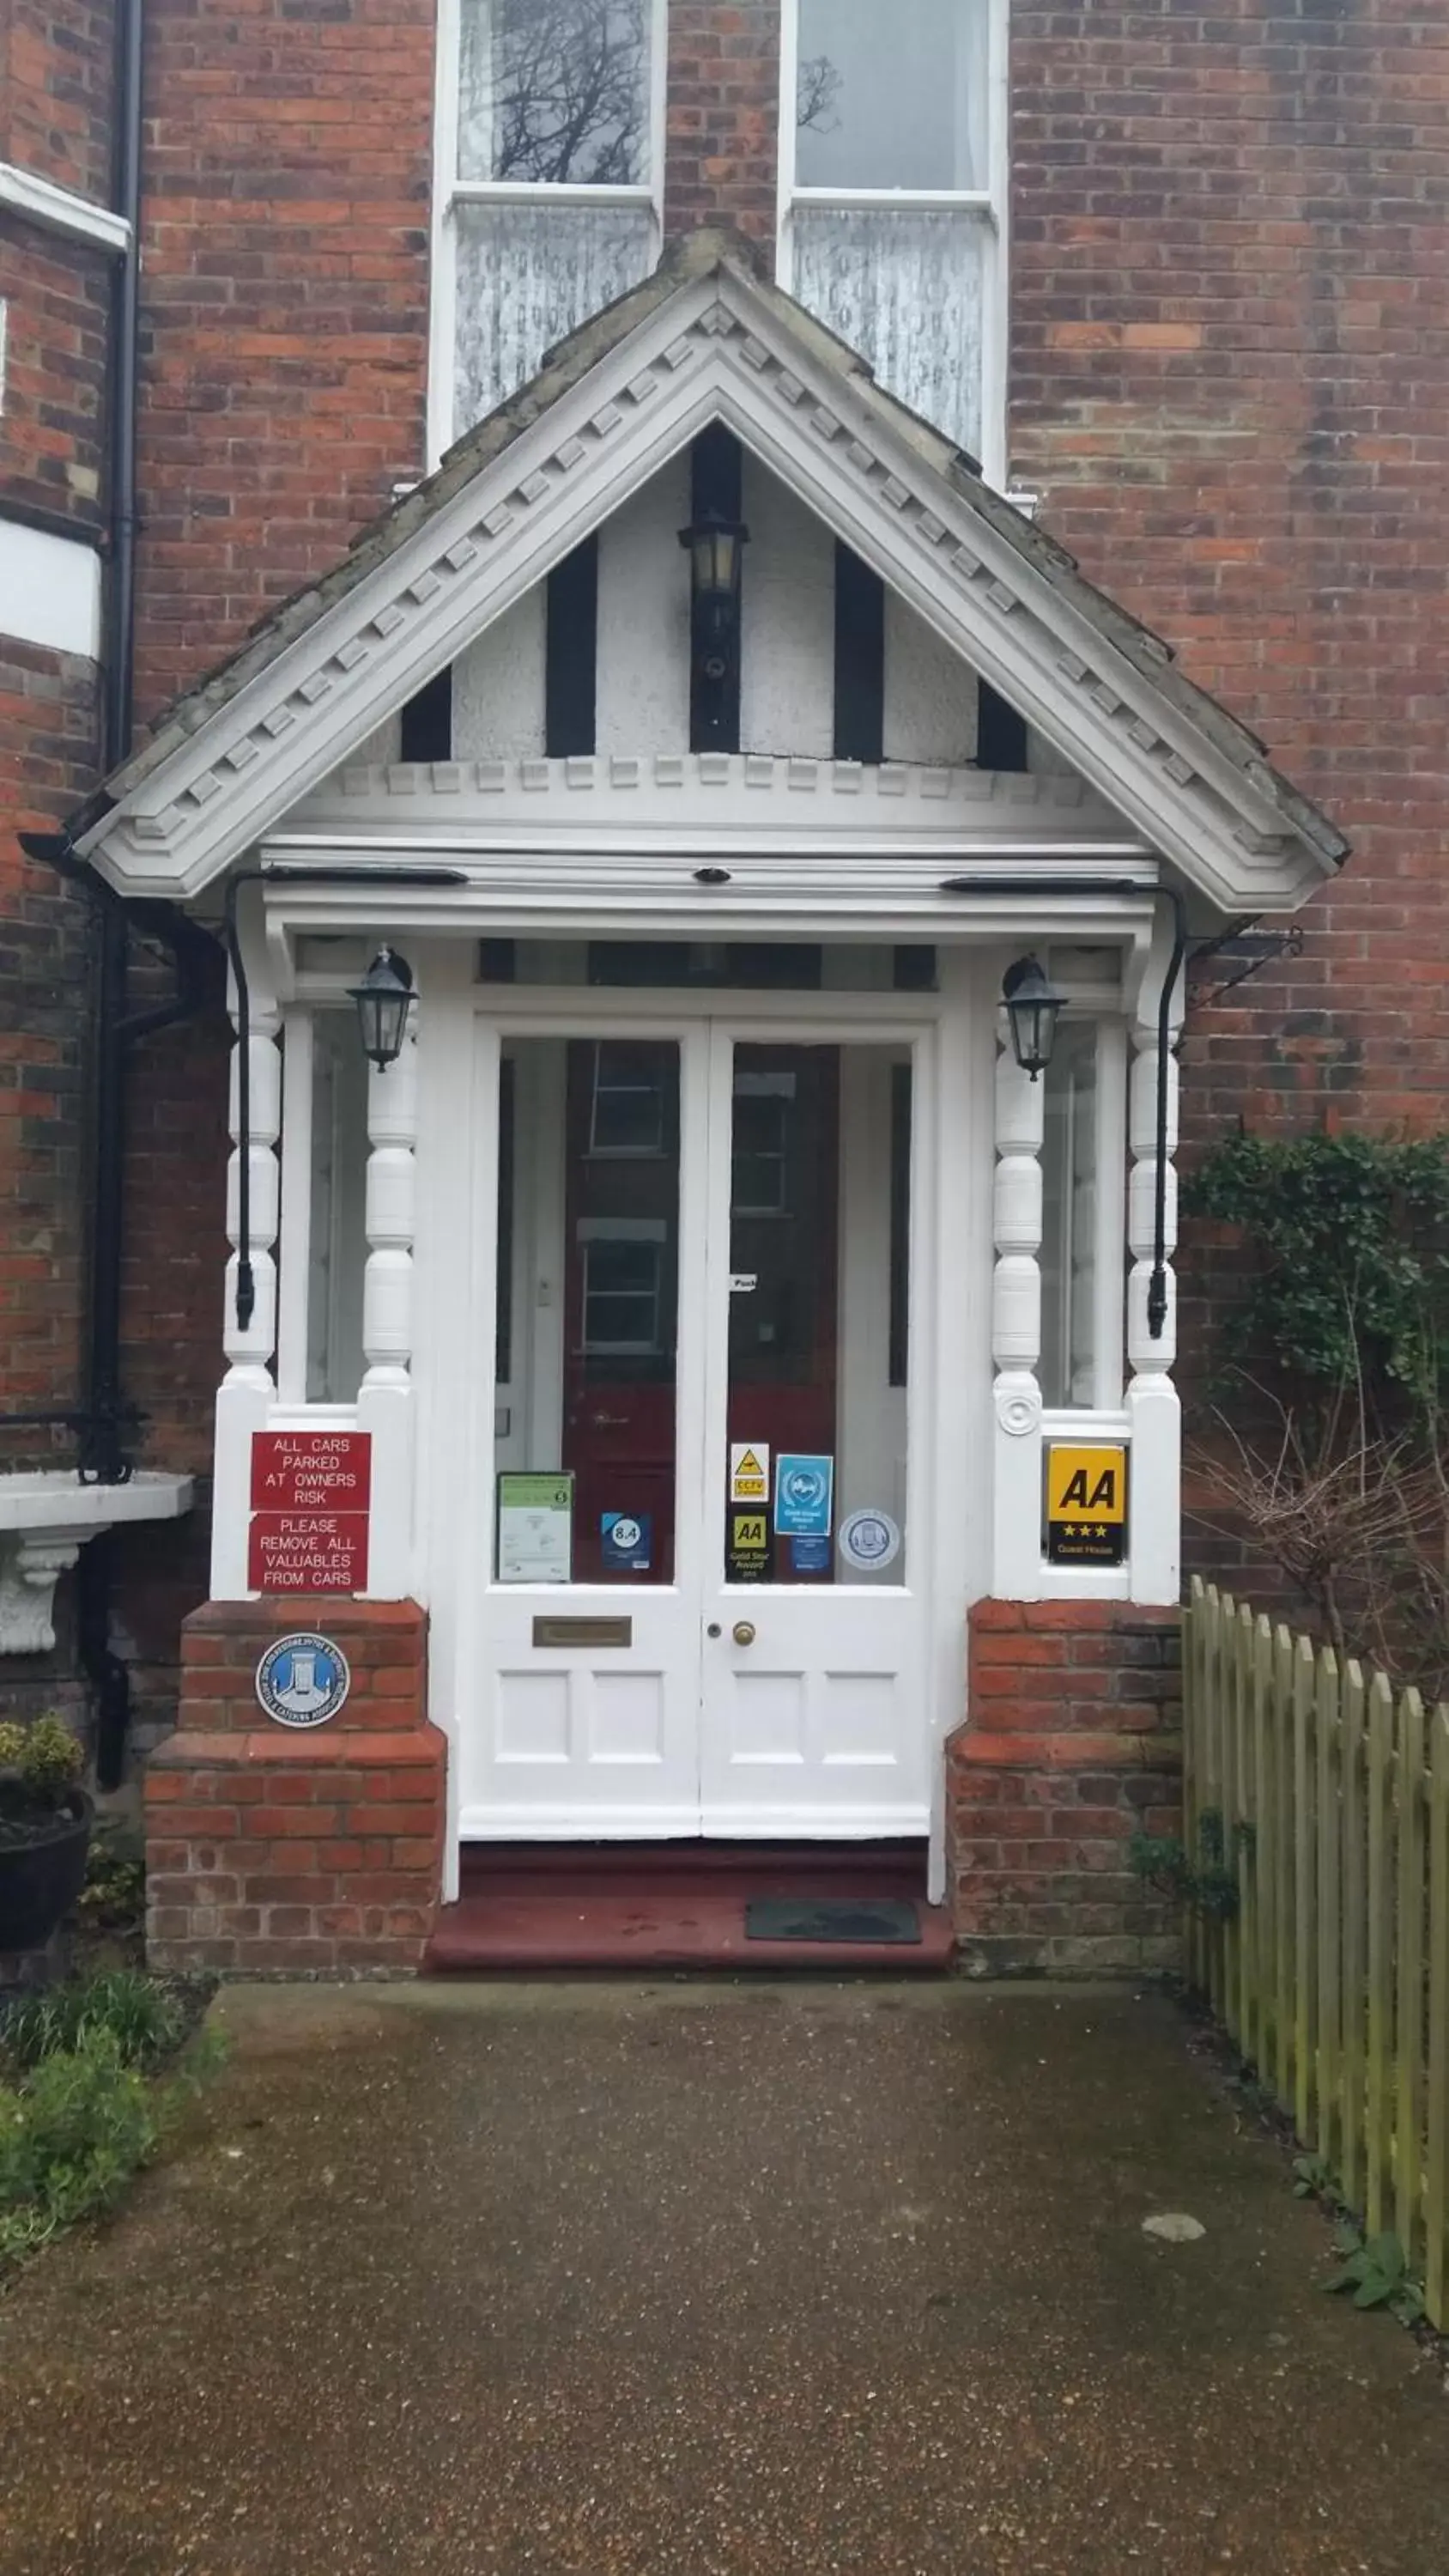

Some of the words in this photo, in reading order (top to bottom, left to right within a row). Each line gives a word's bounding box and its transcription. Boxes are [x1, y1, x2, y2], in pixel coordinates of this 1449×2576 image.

[274, 1439, 302, 1452] ALL
[312, 1439, 350, 1452] CARS
[282, 1455, 340, 1469] PARKED
[265, 1473, 286, 1486] AT
[294, 1473, 357, 1487] OWNERS
[737, 1480, 763, 1489] CCTV
[1058, 1469, 1115, 1509] AA
[294, 1490, 327, 1504] RISK
[281, 1519, 338, 1533] PLEASE
[737, 1522, 761, 1540] AA
[615, 1527, 636, 1540] 8.4
[260, 1536, 318, 1550] REMOVE
[327, 1536, 357, 1550] ALL
[265, 1554, 352, 1568] VALUABLES
[263, 1571, 304, 1586] FROM
[312, 1571, 352, 1586] CARS
